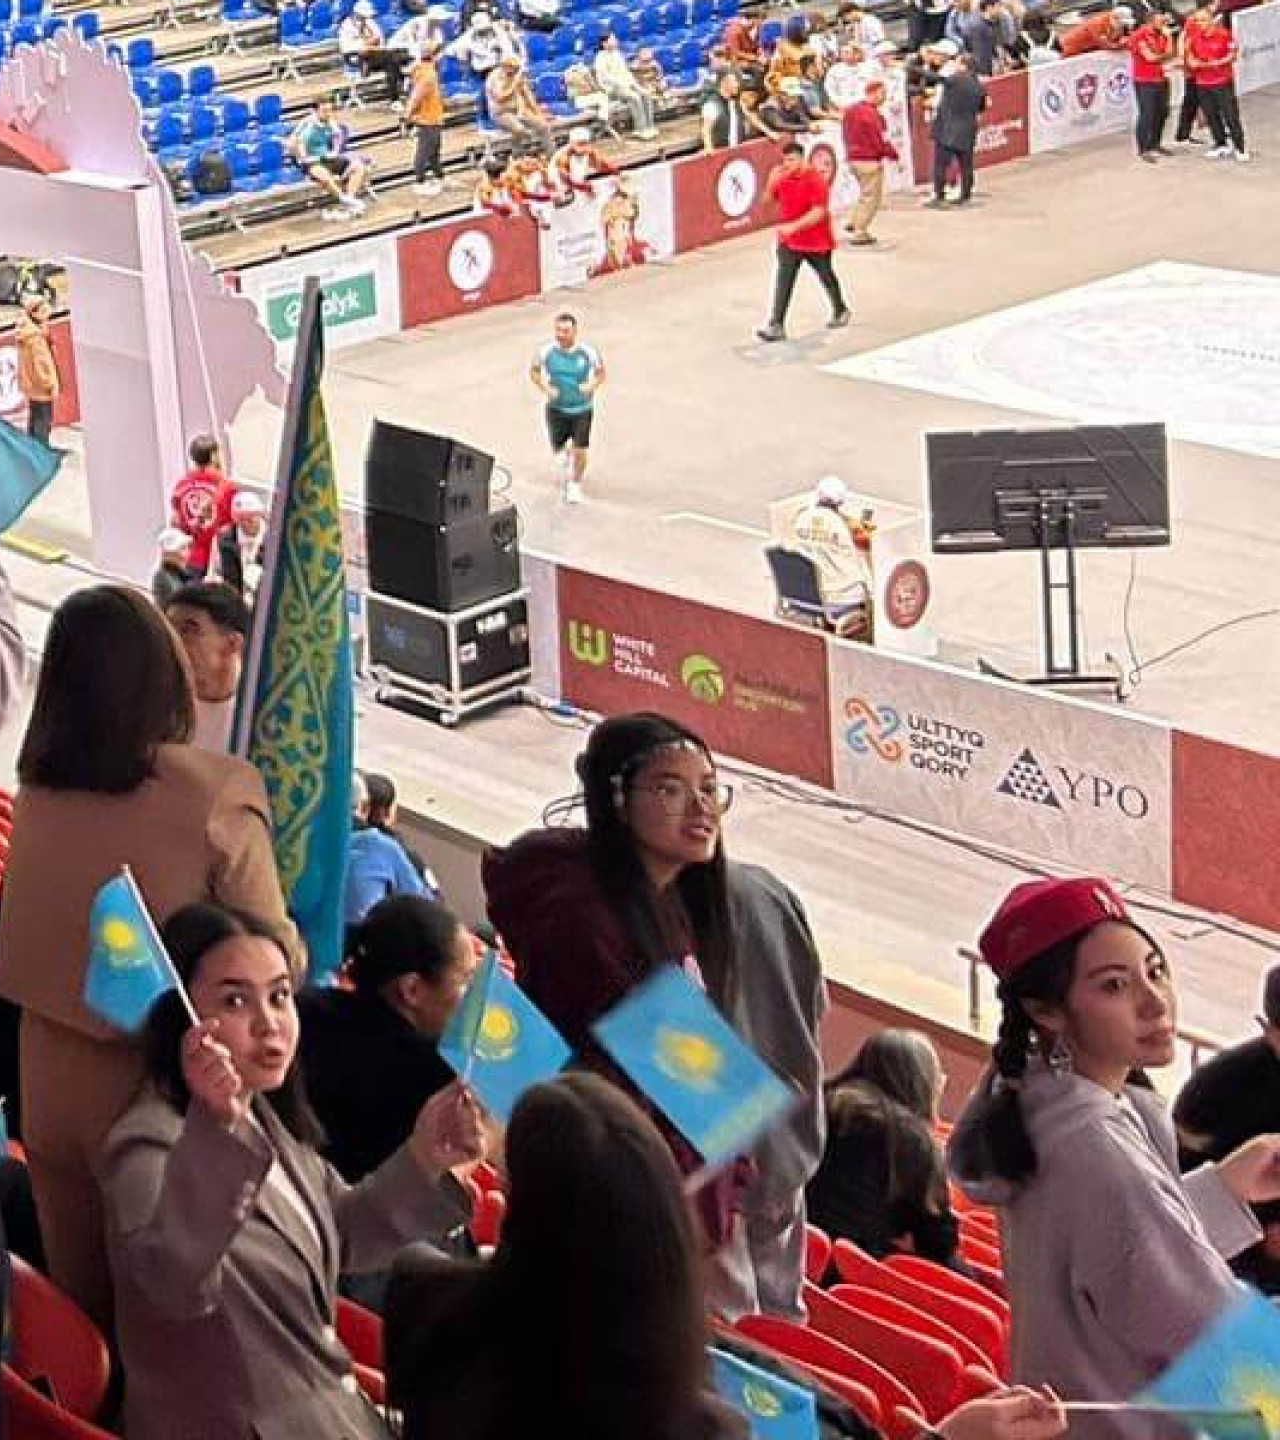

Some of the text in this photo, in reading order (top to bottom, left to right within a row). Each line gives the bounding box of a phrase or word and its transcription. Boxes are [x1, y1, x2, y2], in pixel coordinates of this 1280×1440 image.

[612, 633, 656, 657] WHITE
[613, 659, 670, 688] CAPITAL
[909, 733, 974, 764] SPORT
[910, 753, 971, 780] QORY
[1058, 765, 1150, 820] YPO
